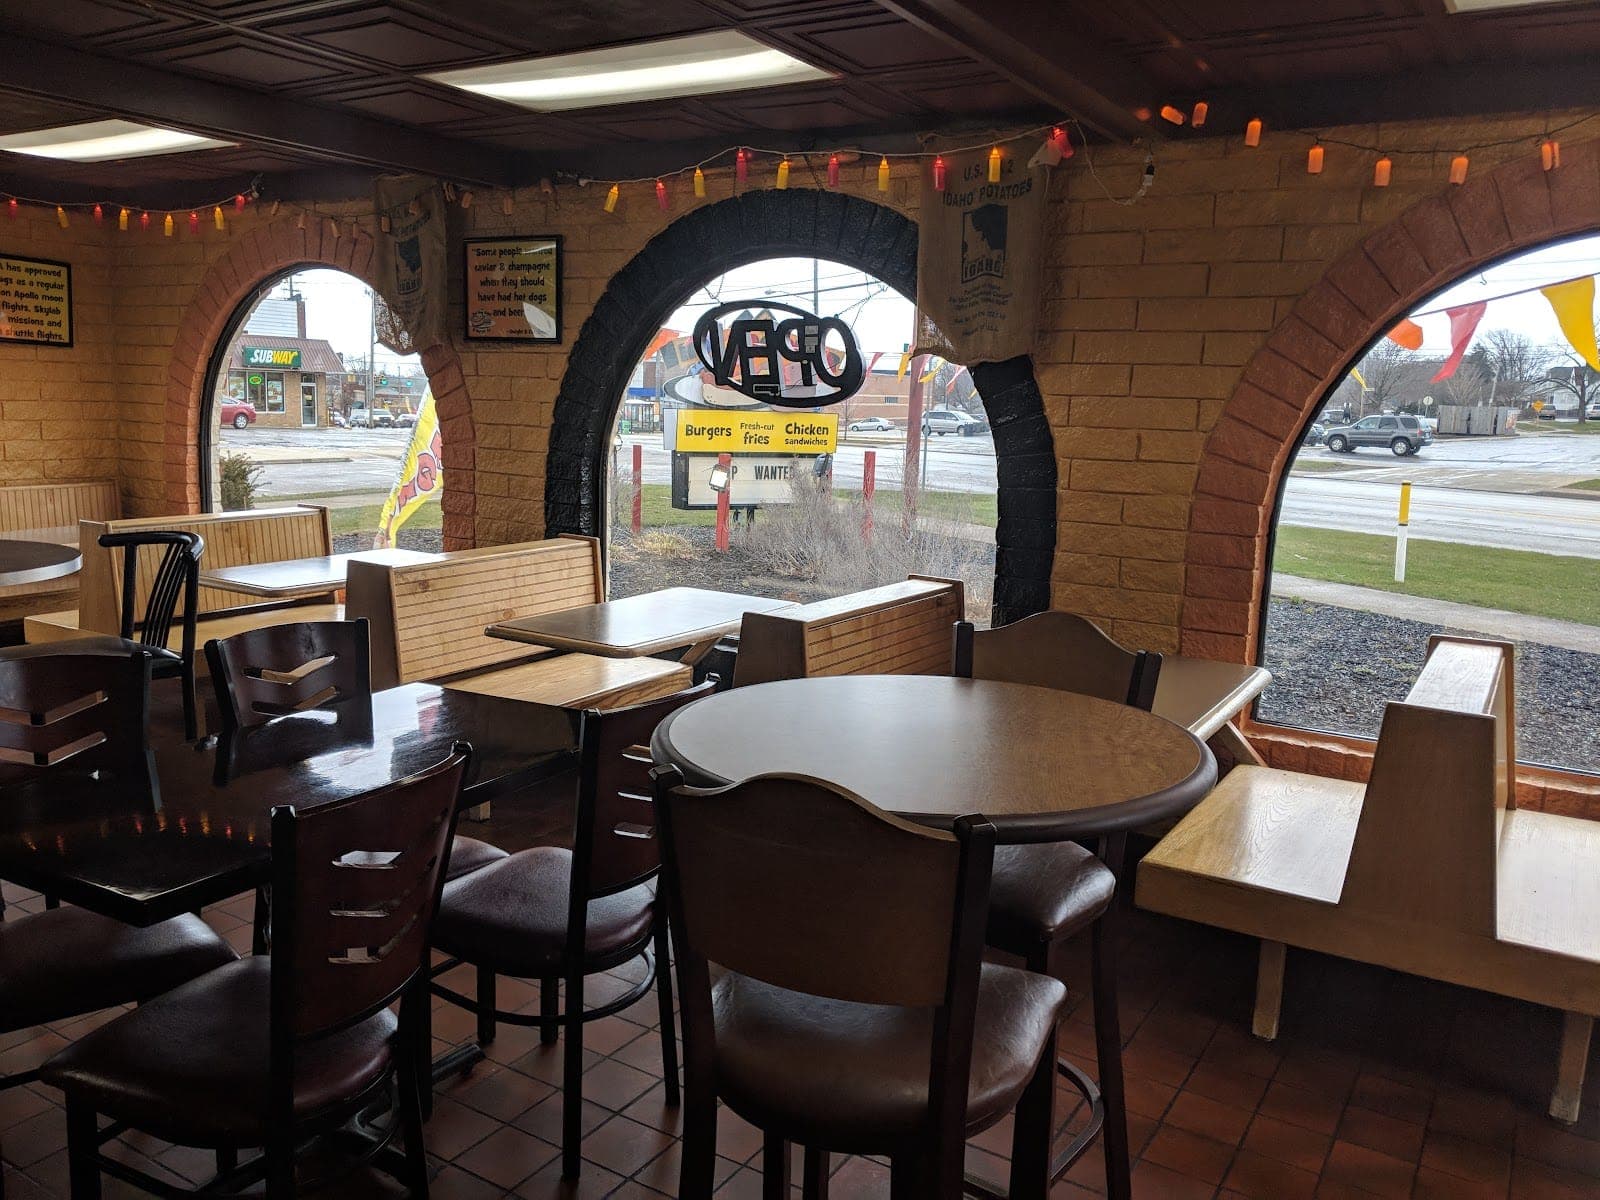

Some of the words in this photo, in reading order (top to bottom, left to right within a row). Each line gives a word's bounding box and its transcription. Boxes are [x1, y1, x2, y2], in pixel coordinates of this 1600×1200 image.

[943, 191, 973, 207] IDAHO
[979, 177, 1032, 202] POTATOES
[6, 262, 21, 272] has
[24, 267, 61, 278] approved
[499, 262, 505, 271] &
[508, 261, 550, 273] champagne
[36, 281, 64, 291] regular
[502, 276, 517, 288] they
[520, 276, 544, 287] should
[0, 289, 10, 297] on
[14, 290, 39, 300] Apollo
[42, 294, 64, 302] moon
[478, 291, 496, 302] have
[497, 291, 511, 302] had
[514, 291, 525, 302] hot
[528, 291, 547, 304] dogs
[34, 305, 61, 316] Skylab
[493, 307, 506, 317] and
[8, 316, 44, 326] missions
[47, 320, 62, 328] and
[250, 349, 298, 365] SUBWAY
[685, 425, 732, 440] Burgers
[740, 422, 775, 431] Fresh-cut
[785, 422, 829, 436] Chicken
[743, 432, 770, 445] fries
[784, 437, 828, 446] sandwiches
